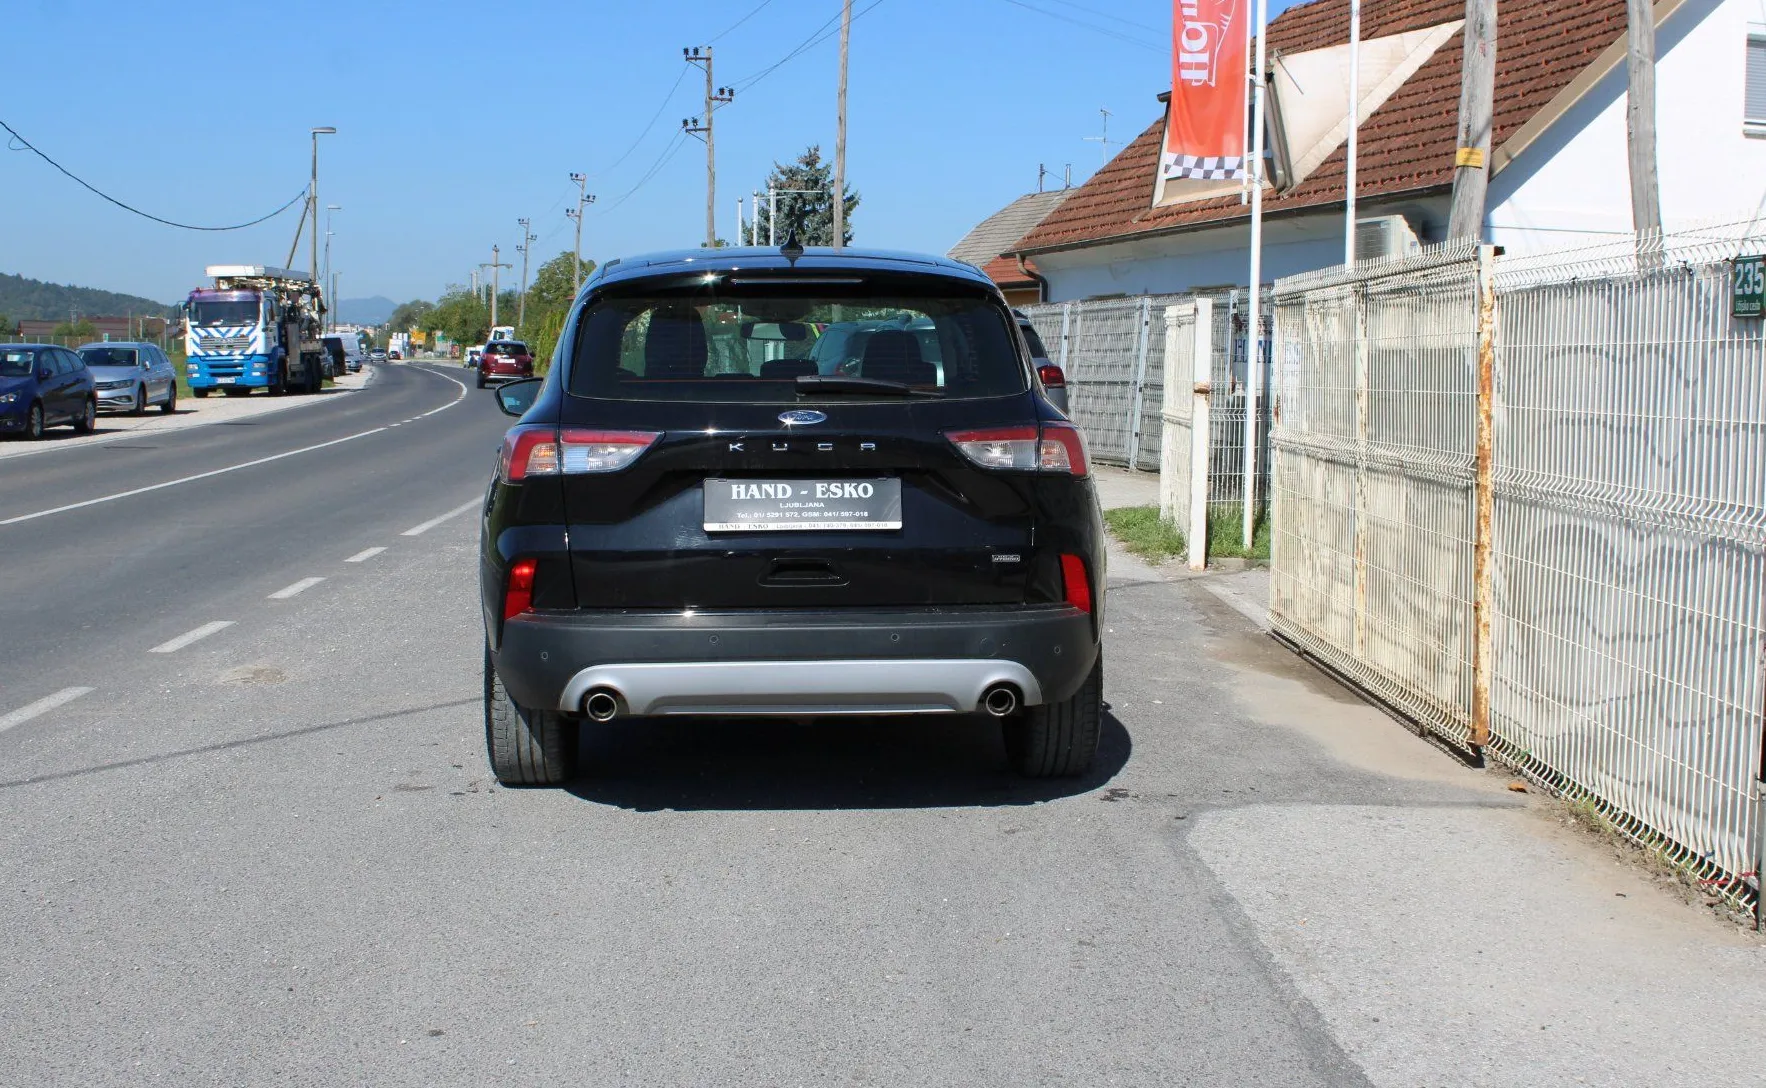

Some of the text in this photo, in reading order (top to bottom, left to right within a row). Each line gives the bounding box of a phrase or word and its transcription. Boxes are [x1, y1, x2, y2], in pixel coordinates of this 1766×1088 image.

[1735, 261, 1764, 295] 235
[729, 443, 876, 451] KUGA
[731, 484, 792, 499] HAND
[815, 483, 874, 498] ESKO
